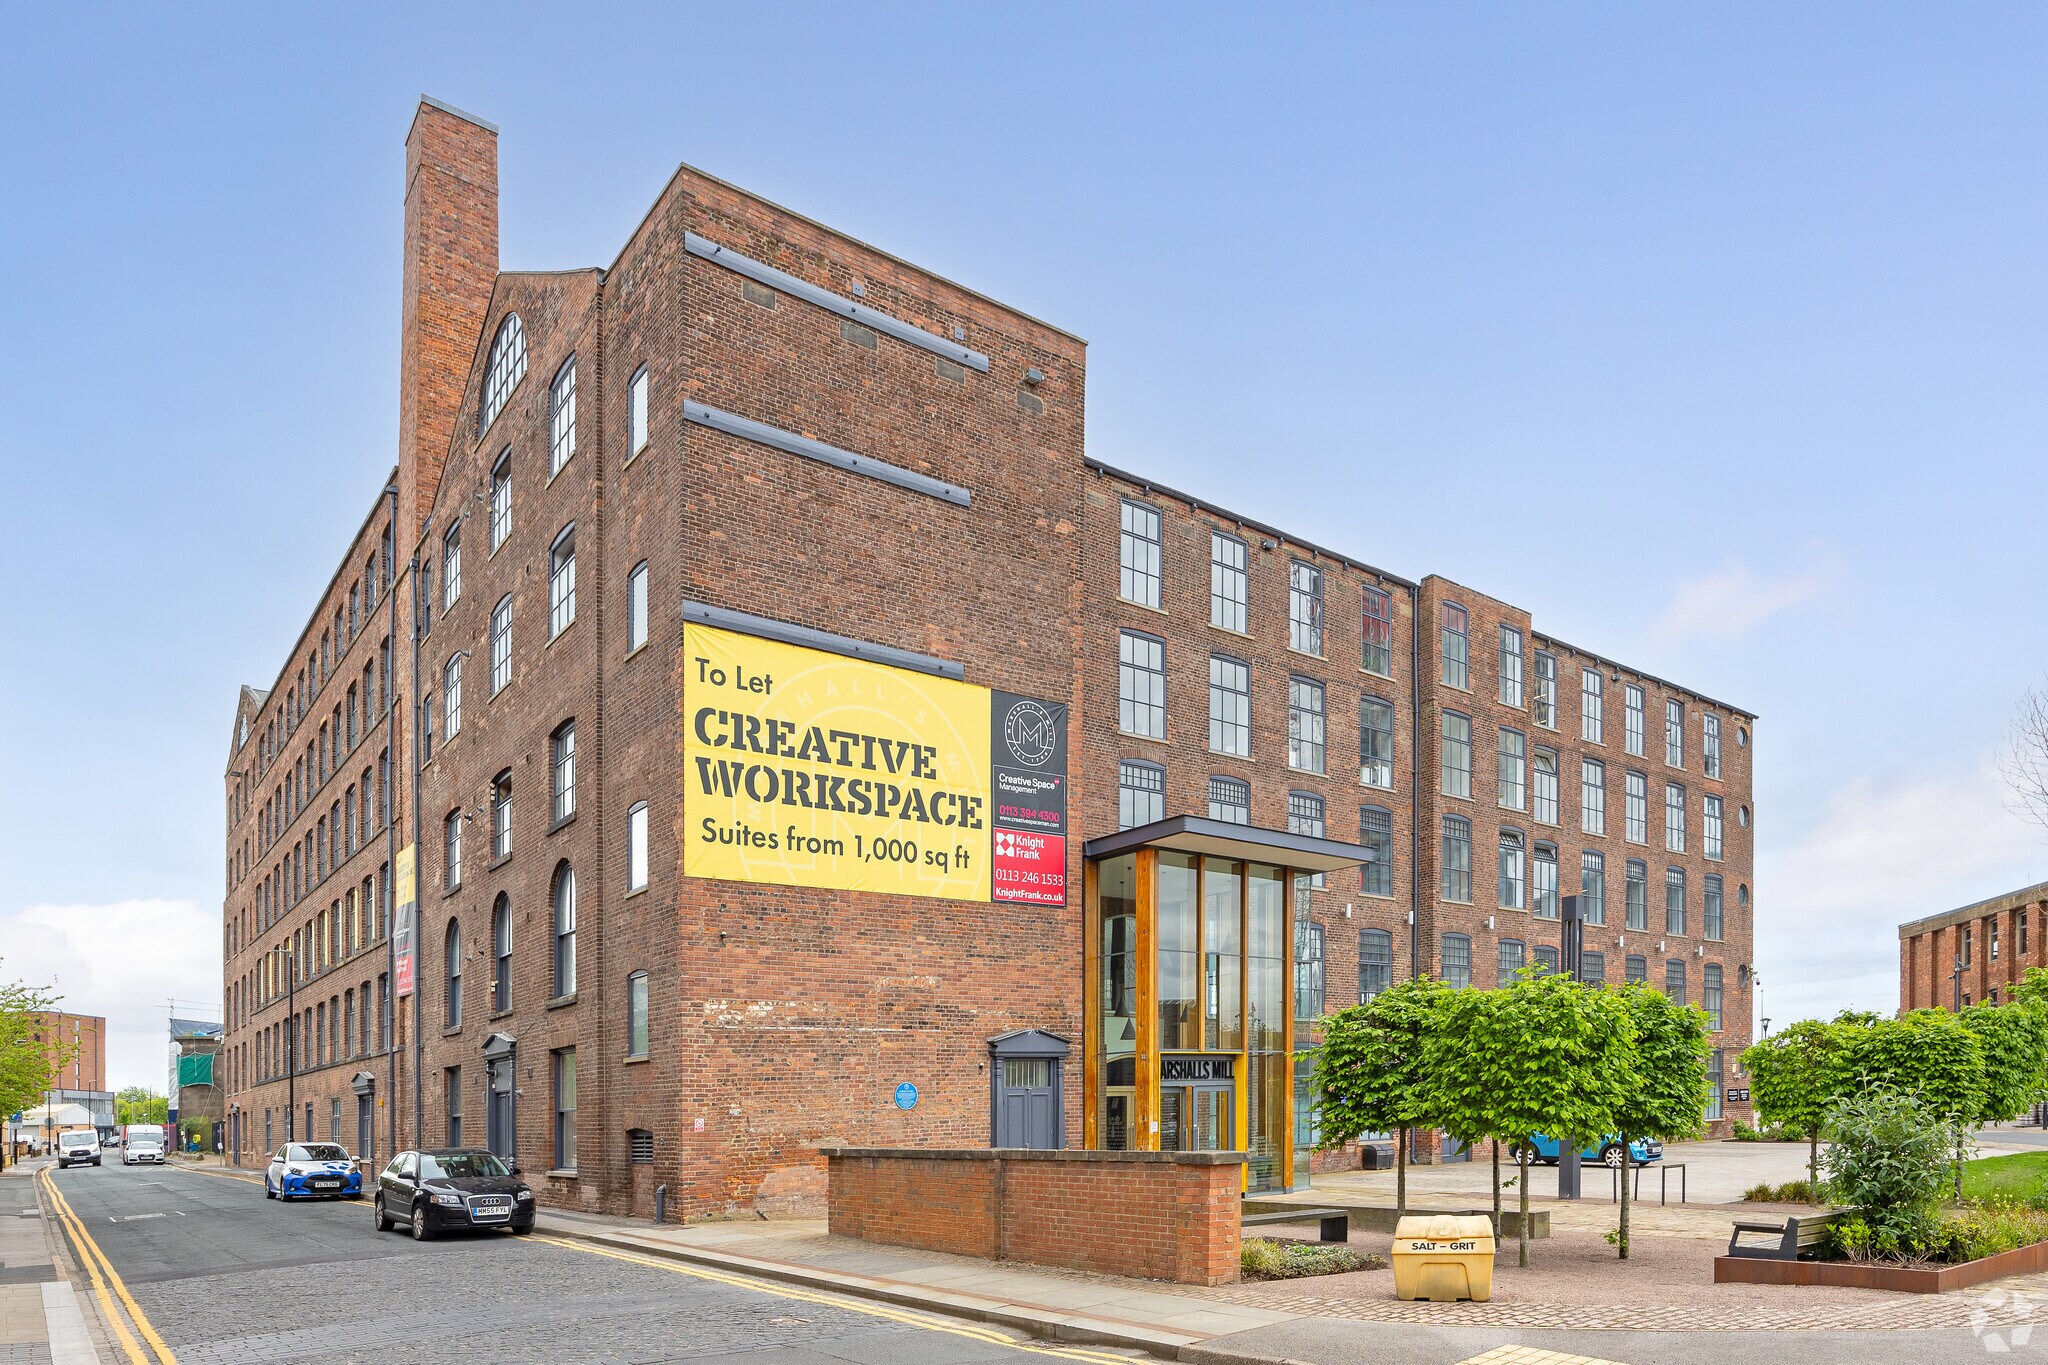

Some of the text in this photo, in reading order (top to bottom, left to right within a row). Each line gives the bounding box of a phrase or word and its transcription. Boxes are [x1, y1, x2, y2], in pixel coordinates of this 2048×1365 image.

[695, 657, 773, 695] To Let
[694, 707, 937, 780] CREATIVE
[999, 773, 1032, 786] Creative
[1032, 778, 1056, 790] Space
[999, 782, 1037, 795] Management
[695, 756, 982, 829] WORKSPACE
[999, 804, 1060, 822] 0113 394 4300
[999, 815, 1060, 829] www.creativespaceman.com
[701, 817, 970, 873] Suites from 1,000 sq ft
[1016, 835, 1045, 849] Knight
[1016, 847, 1040, 860] Frank
[995, 868, 1064, 887] 0113 246 1533
[995, 887, 1063, 902] KnightFrank.co.uk
[1161, 1060, 1235, 1080] ARSHALLS MILL
[1411, 1242, 1437, 1251] SALT
[1449, 1242, 1476, 1250] GRIT
